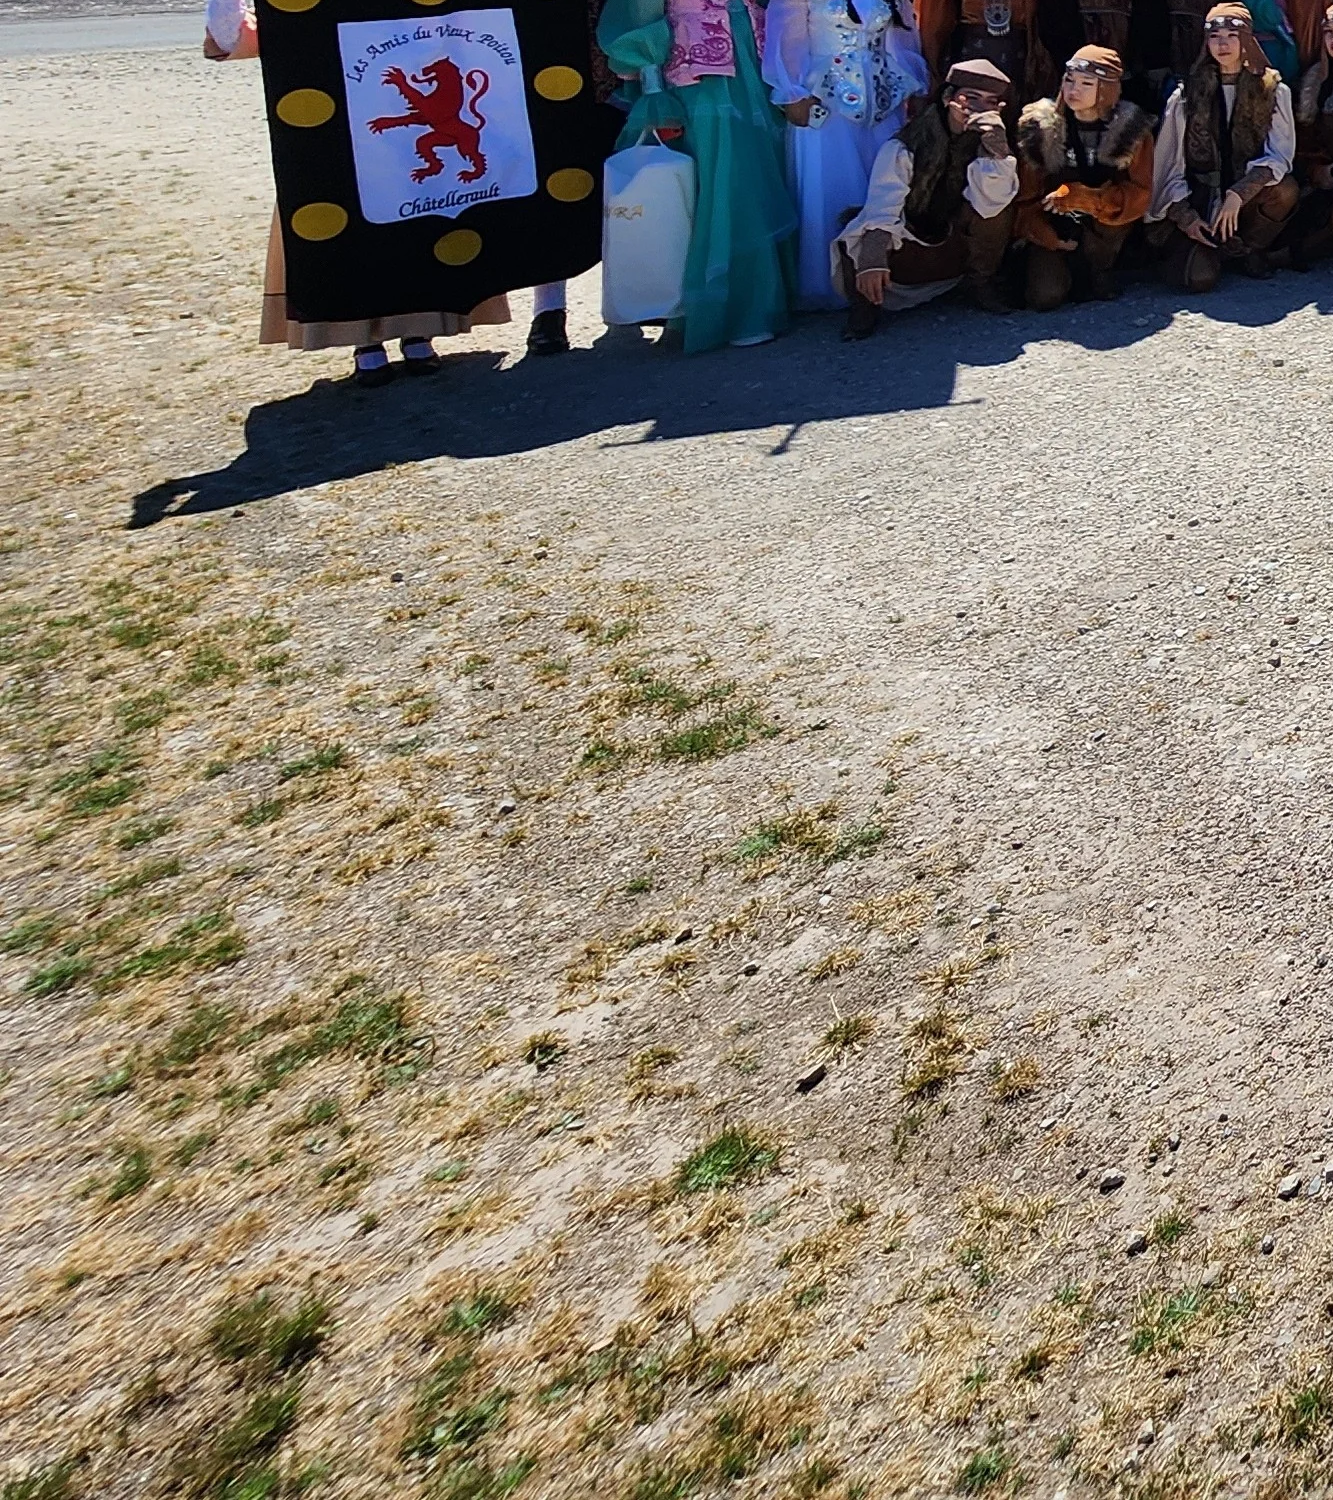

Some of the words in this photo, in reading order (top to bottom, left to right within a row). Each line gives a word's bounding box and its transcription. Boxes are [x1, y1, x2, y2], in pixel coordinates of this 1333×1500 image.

[346, 58, 369, 84] Les
[366, 33, 409, 60] Amis
[413, 25, 433, 41] du
[436, 24, 475, 43] Vieux
[476, 33, 517, 66] Poitou
[399, 182, 501, 218] Châtellerault
